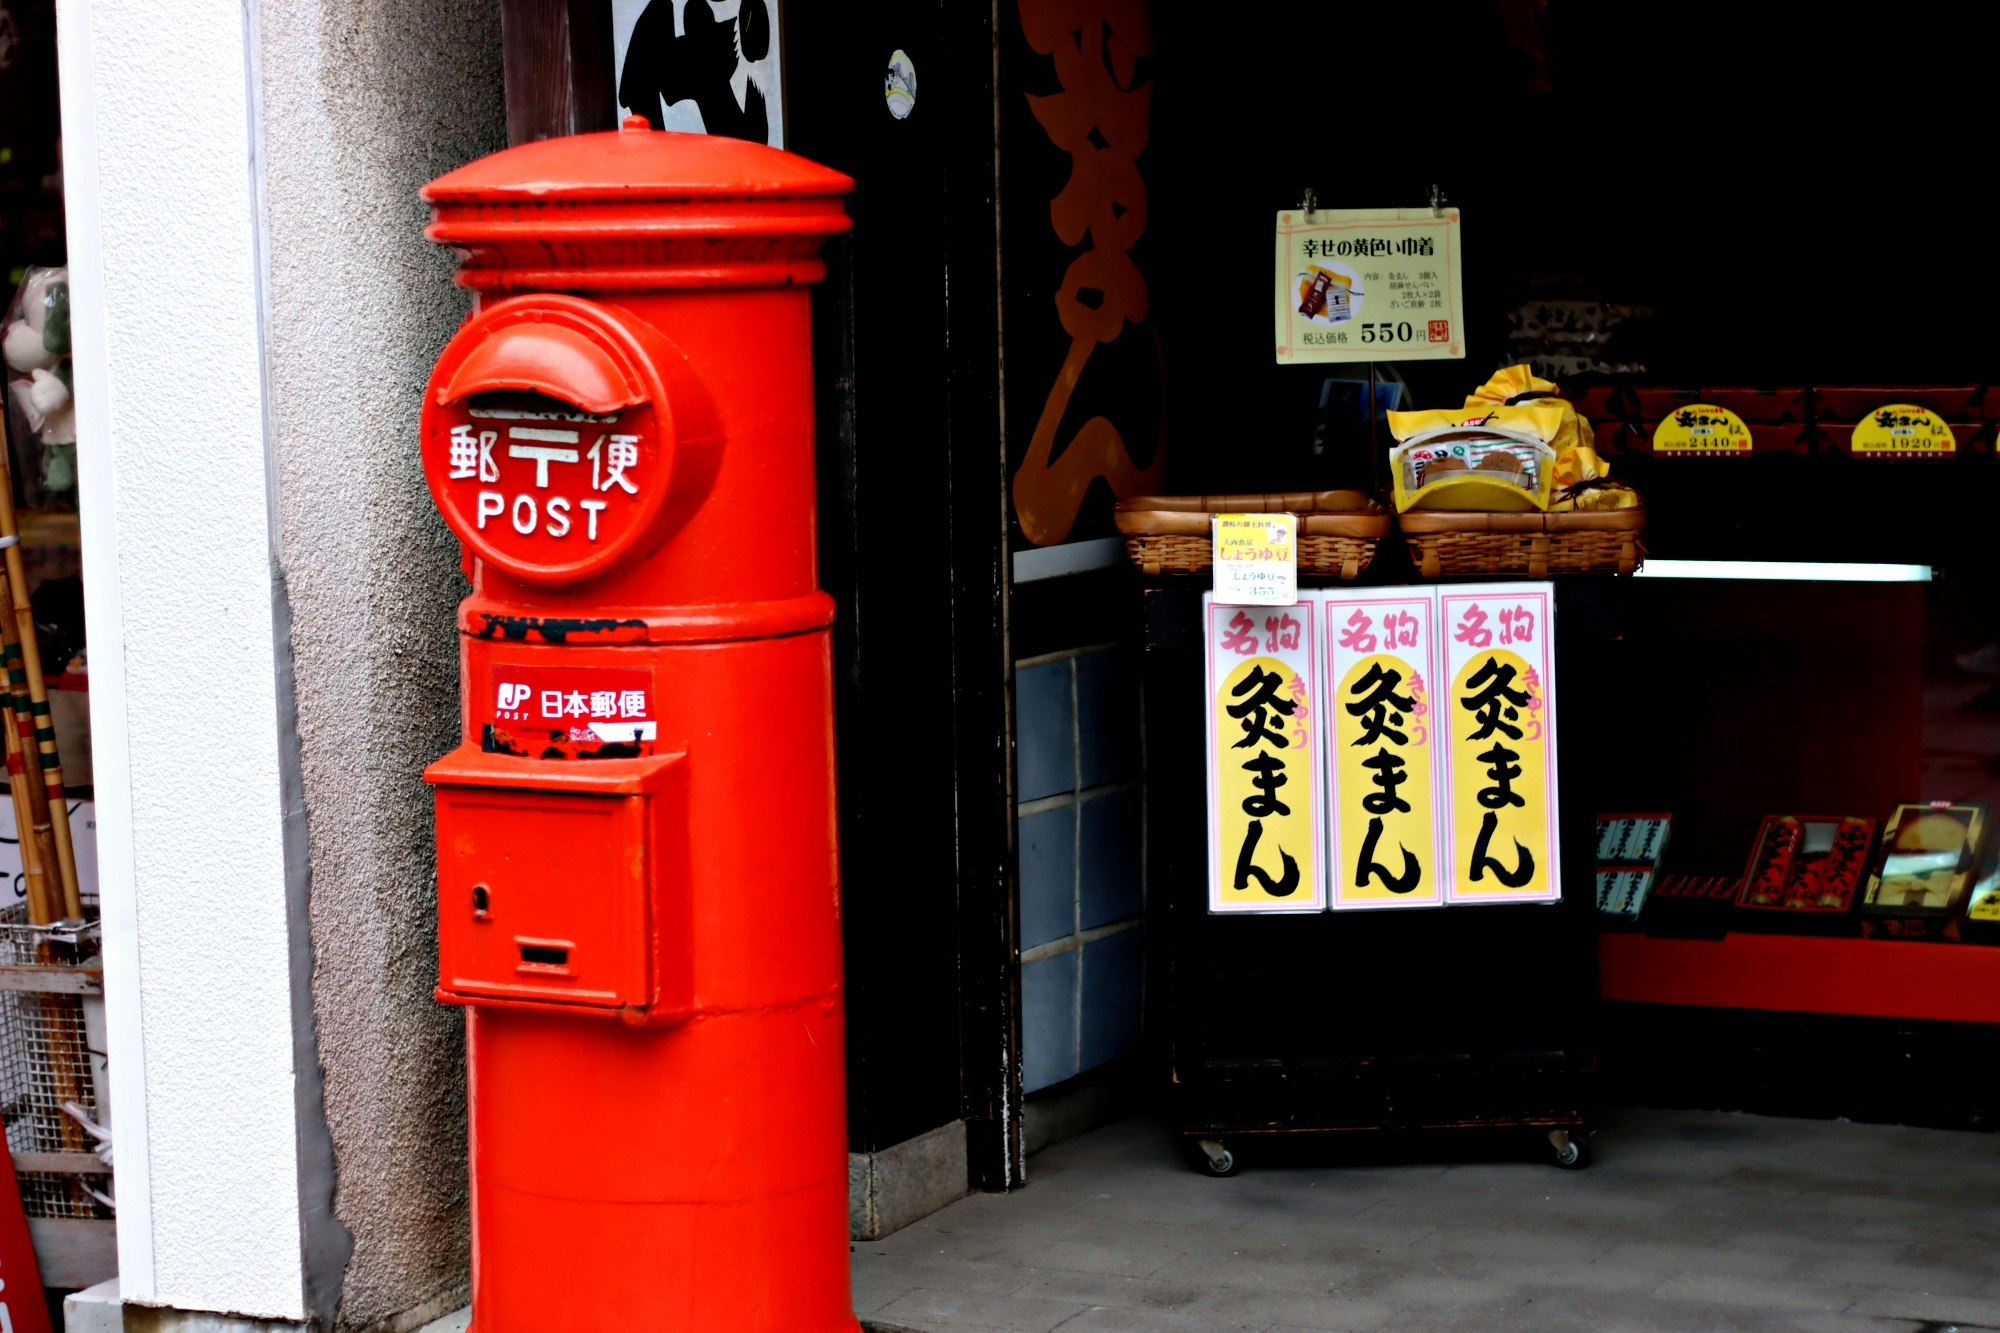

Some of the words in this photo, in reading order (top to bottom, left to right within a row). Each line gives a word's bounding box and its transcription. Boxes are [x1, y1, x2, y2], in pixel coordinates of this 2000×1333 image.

[1302, 237, 1434, 257] 幸せの黄色い巾着
[1303, 332, 1348, 345] 税込価格
[1361, 321, 1413, 343] 550
[1416, 330, 1426, 342] 円
[1689, 437, 1730, 448] 2440
[1890, 437, 1931, 449] 1920
[477, 491, 607, 541] POST
[1220, 546, 1290, 562] しょうゆ豆
[1220, 609, 1301, 655] 名物
[1338, 605, 1419, 653] 名物
[1453, 603, 1536, 650] 名物
[495, 710, 530, 721] POST
[497, 682, 531, 710] JP
[541, 689, 647, 719] 日本郵便
[1287, 673, 1309, 750] きゅう
[1406, 669, 1428, 747] きゅう
[1519, 664, 1543, 742] きゅう
[1225, 661, 1301, 897] 灸まん
[1345, 661, 1422, 894] 灸まん
[1460, 656, 1536, 890] 灸まん
